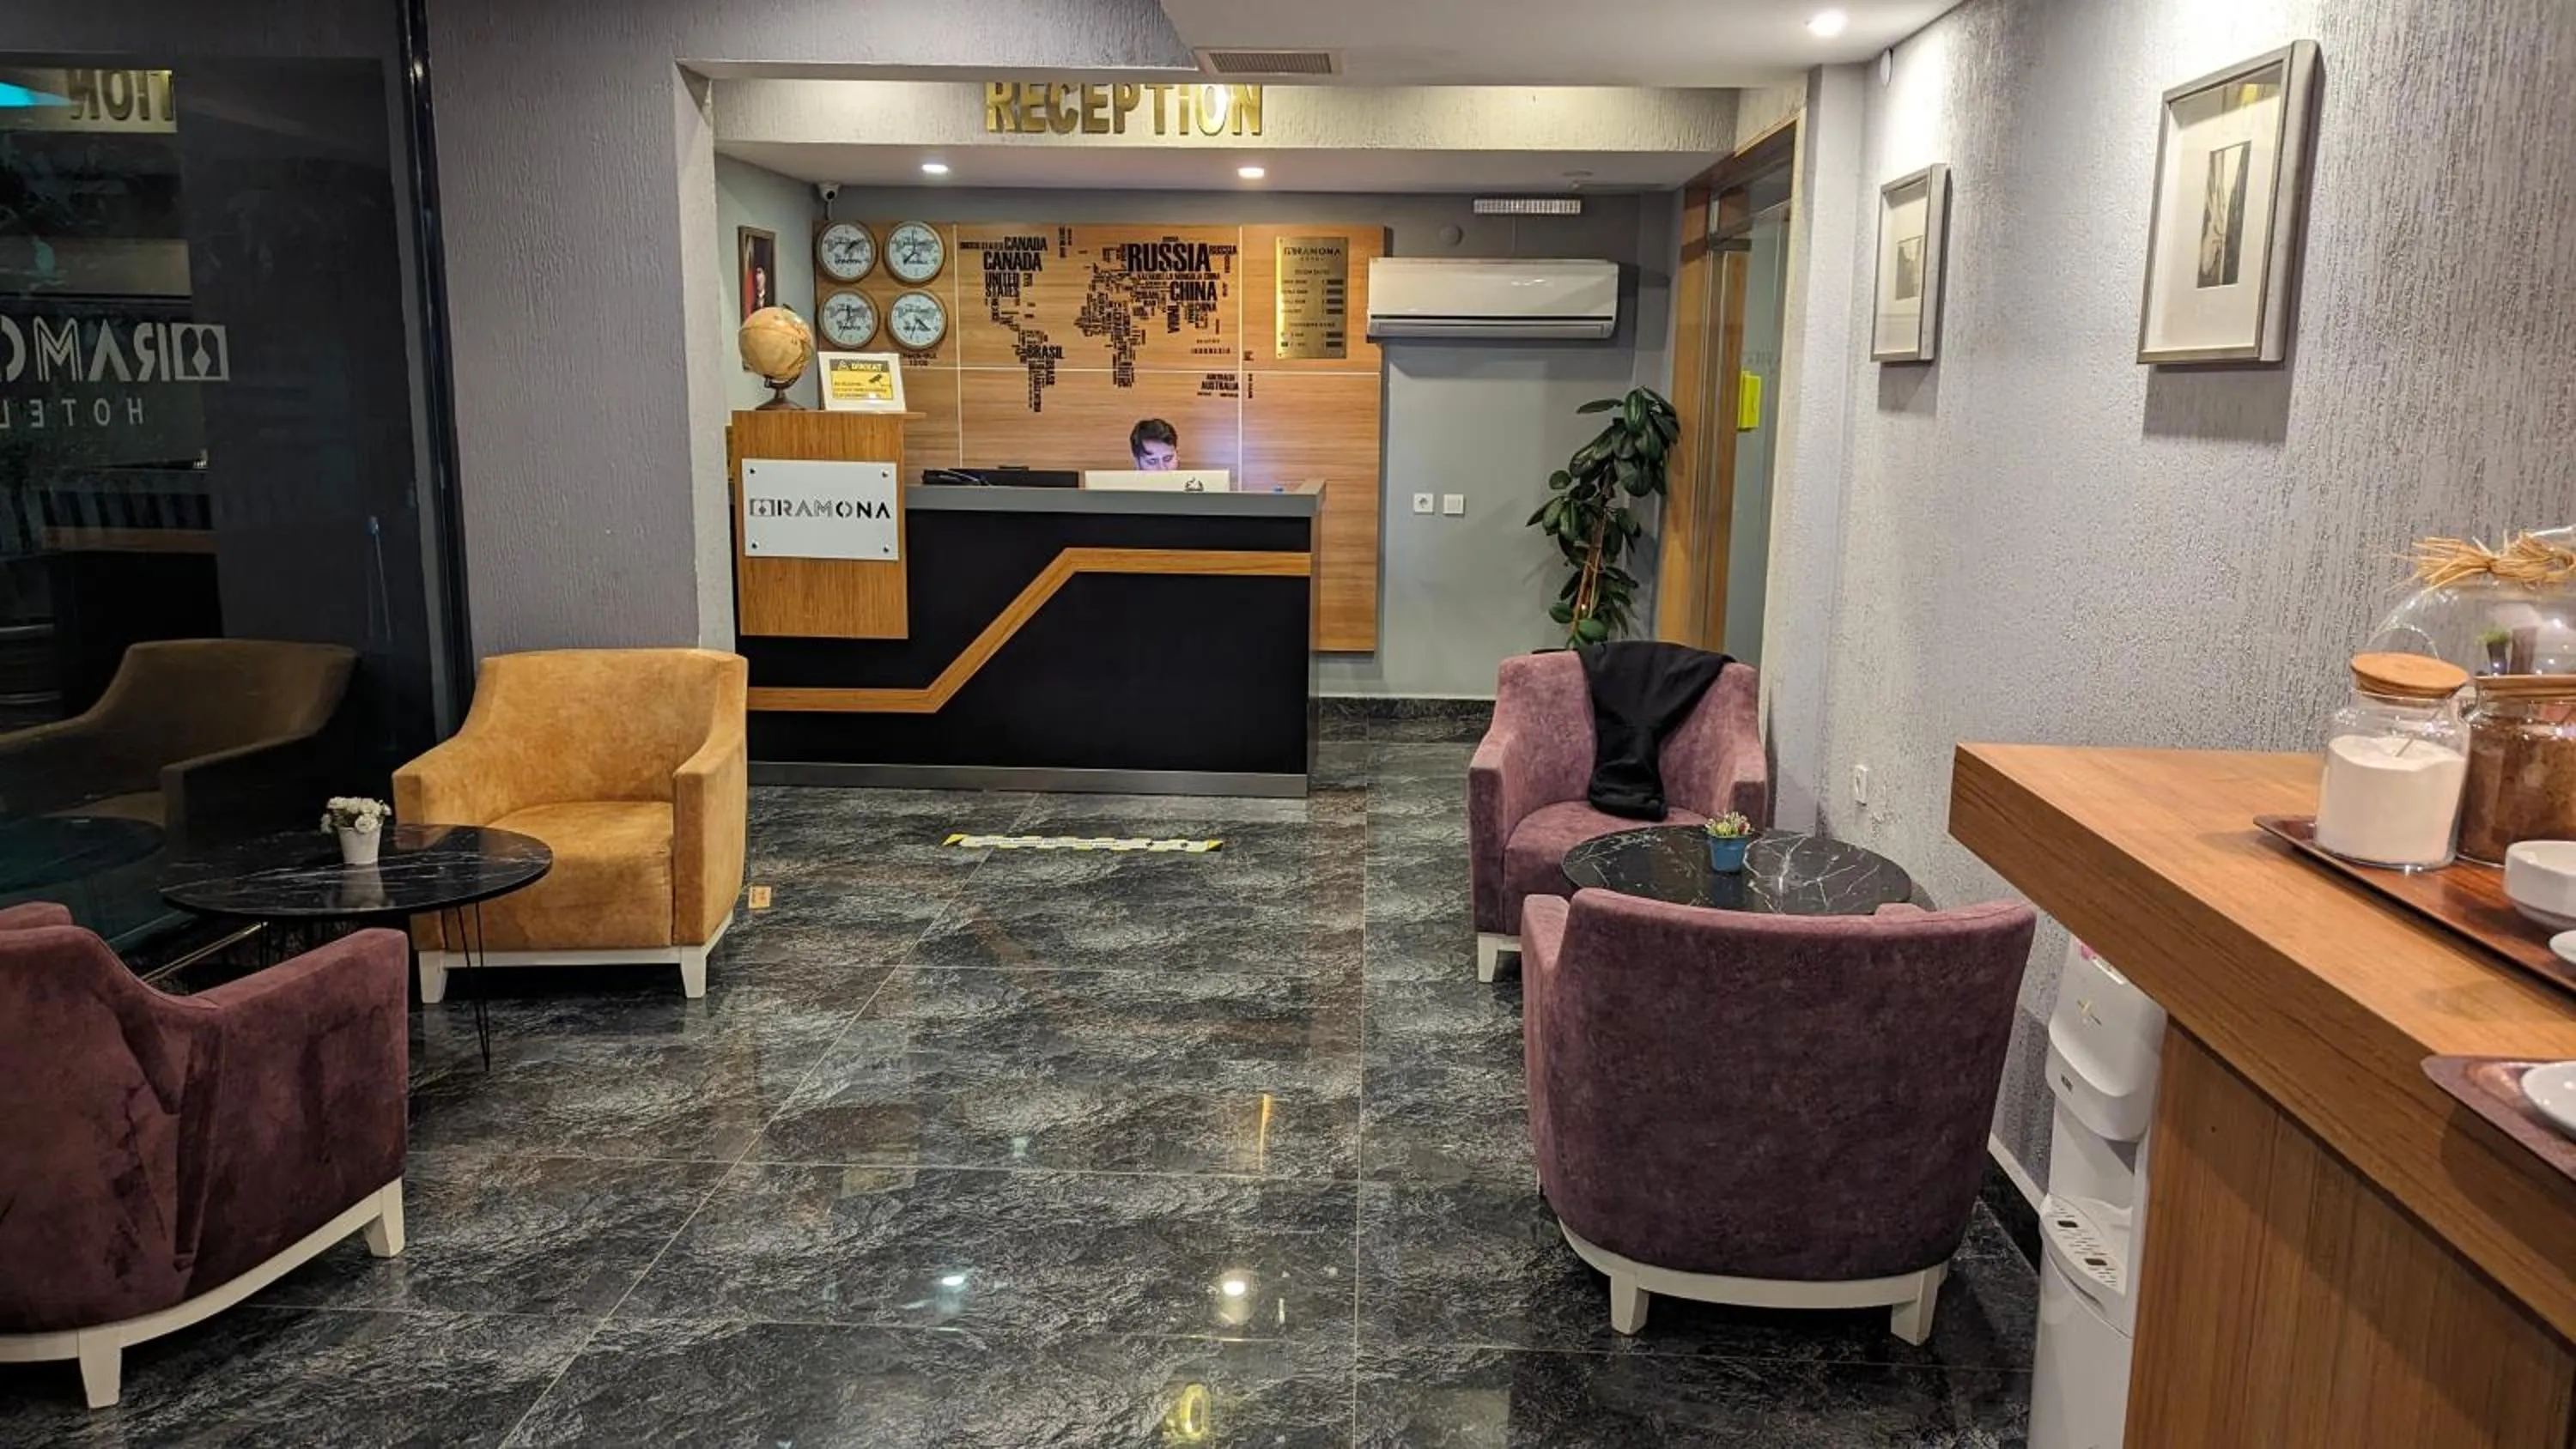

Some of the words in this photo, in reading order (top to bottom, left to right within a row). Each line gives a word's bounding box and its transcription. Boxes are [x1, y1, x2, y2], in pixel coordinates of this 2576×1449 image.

[1003, 236, 1048, 252] CANADA
[983, 252, 1042, 272] CANADA
[1127, 243, 1212, 272] RUSSIA
[985, 272, 1020, 287] UNITED
[985, 286, 1020, 298] STATES
[1170, 281, 1218, 301] CHINA
[776, 499, 890, 519] RAMONA
